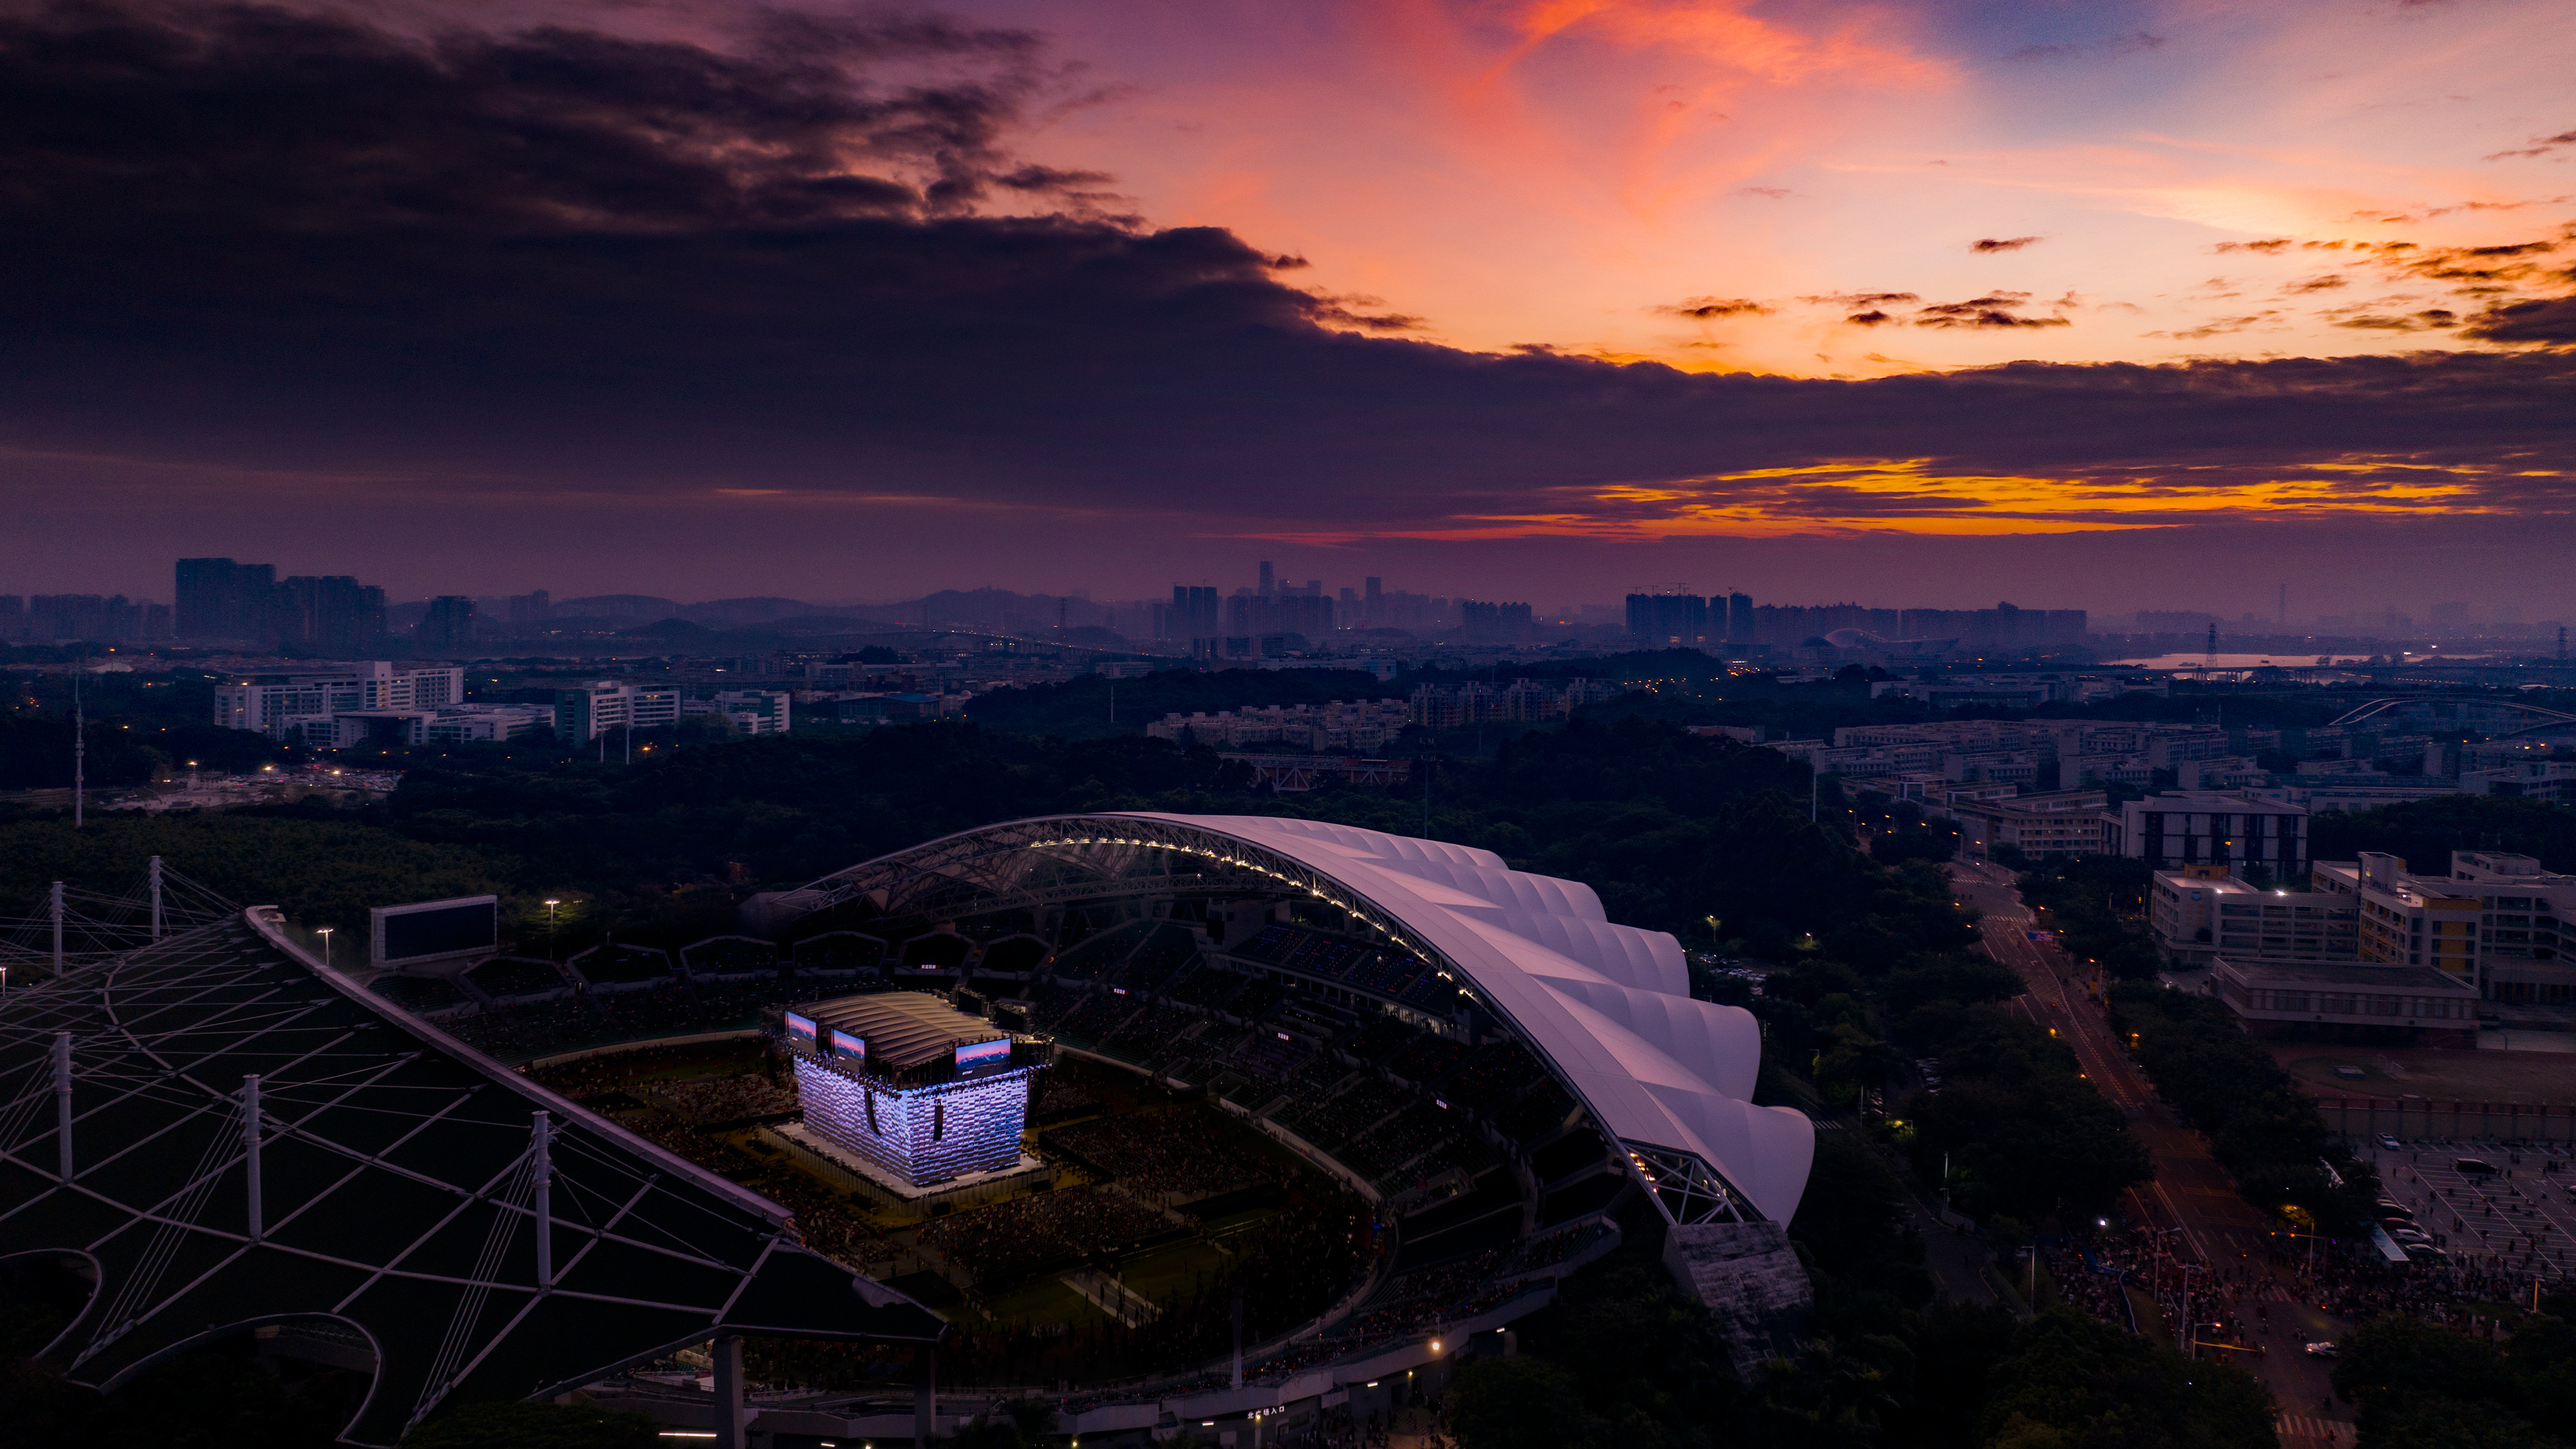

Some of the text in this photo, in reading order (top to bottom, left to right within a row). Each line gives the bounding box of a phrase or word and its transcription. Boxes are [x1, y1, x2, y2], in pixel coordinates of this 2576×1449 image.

[1248, 1406, 1284, 1419] 北广场入口
